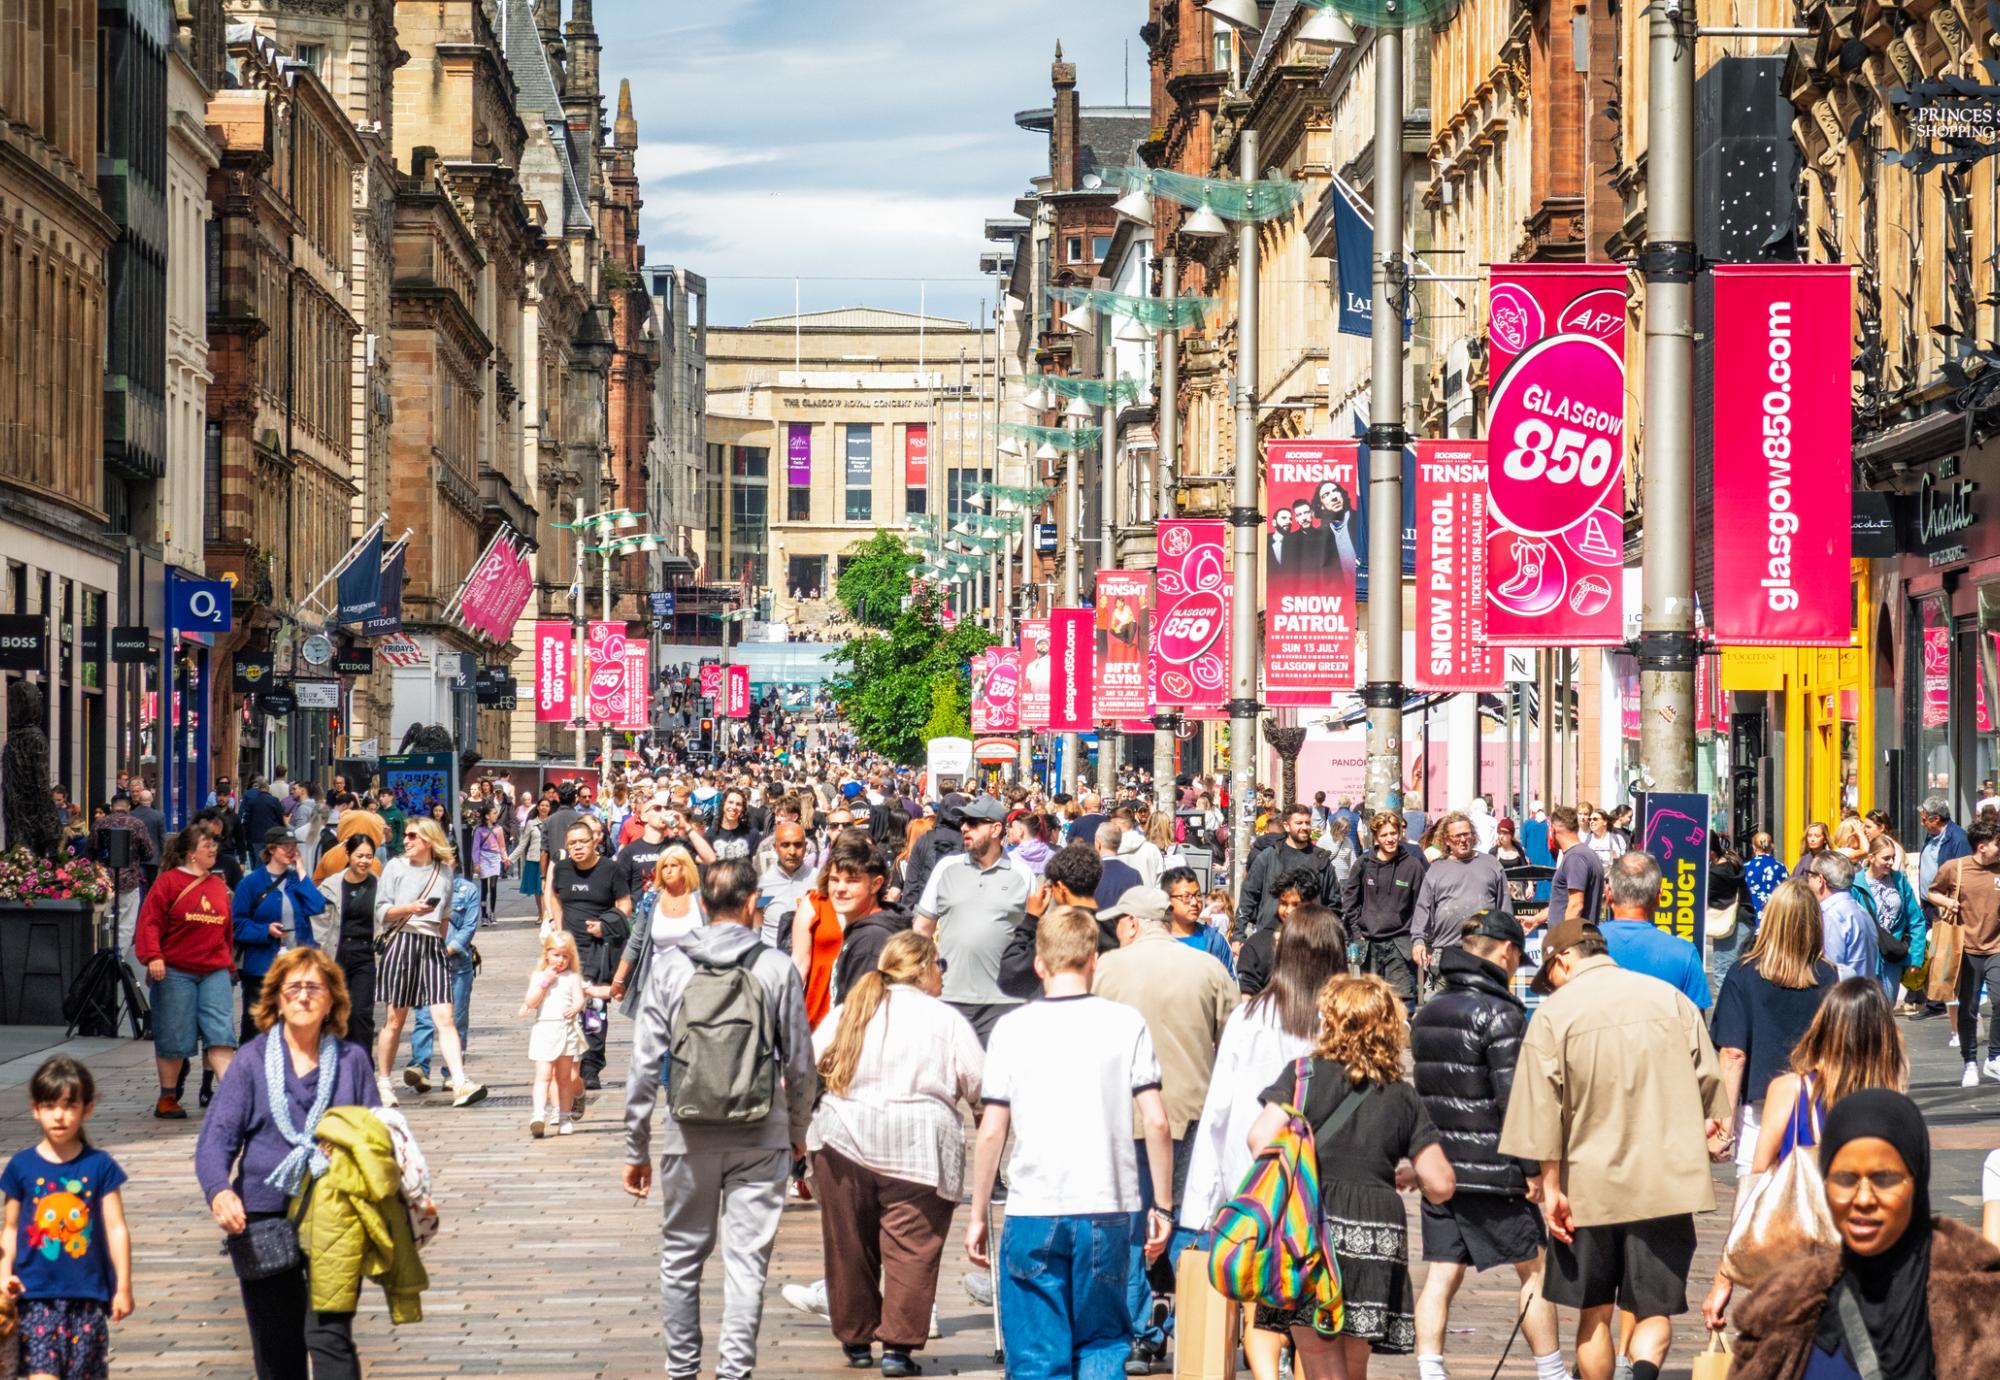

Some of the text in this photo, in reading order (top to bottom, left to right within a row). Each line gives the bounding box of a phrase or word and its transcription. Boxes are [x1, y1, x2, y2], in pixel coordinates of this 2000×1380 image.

[1919, 107, 1992, 123] PRINCES
[1916, 124, 1996, 141] SHOPPING
[1566, 309, 1624, 333] ART
[1522, 384, 1623, 436] GLASGOW
[1503, 418, 1613, 487] 850
[1761, 301, 1799, 611] glasgow850.com
[1271, 464, 1353, 483] TRNSMT
[1420, 464, 1489, 483] TRNSM
[1099, 584, 1148, 596] TRNSMT
[1430, 492, 1454, 676] SNOW PATROL
[1471, 493, 1482, 674] 11-13 JULY TICKETS ON SALE NOW
[1172, 607, 1218, 617] GLASGOW
[1281, 596, 1342, 613] SNOW
[367, 617, 397, 628] TUDOR
[1164, 617, 1211, 642] 850
[1274, 614, 1350, 632] PATROL
[1, 636, 38, 649] BOSS
[383, 645, 414, 653] FRIDAYS
[1281, 643, 1340, 653] SUN 13 JULY
[1727, 652, 1776, 662] L'OCCITANE
[339, 663, 371, 671] TUDOR
[540, 637, 555, 710] Celebrating
[553, 640, 567, 703] 850 years
[1064, 619, 1077, 722] glasgow850.com
[1104, 663, 1141, 673] BIFFY
[1271, 661, 1349, 671] GLASGOW GREEN
[593, 674, 619, 688] 850
[1103, 673, 1141, 685] CLYRO
[989, 681, 1015, 698] 850
[1332, 759, 1367, 767] PANDO
[1676, 858, 1697, 943] NDUCT
